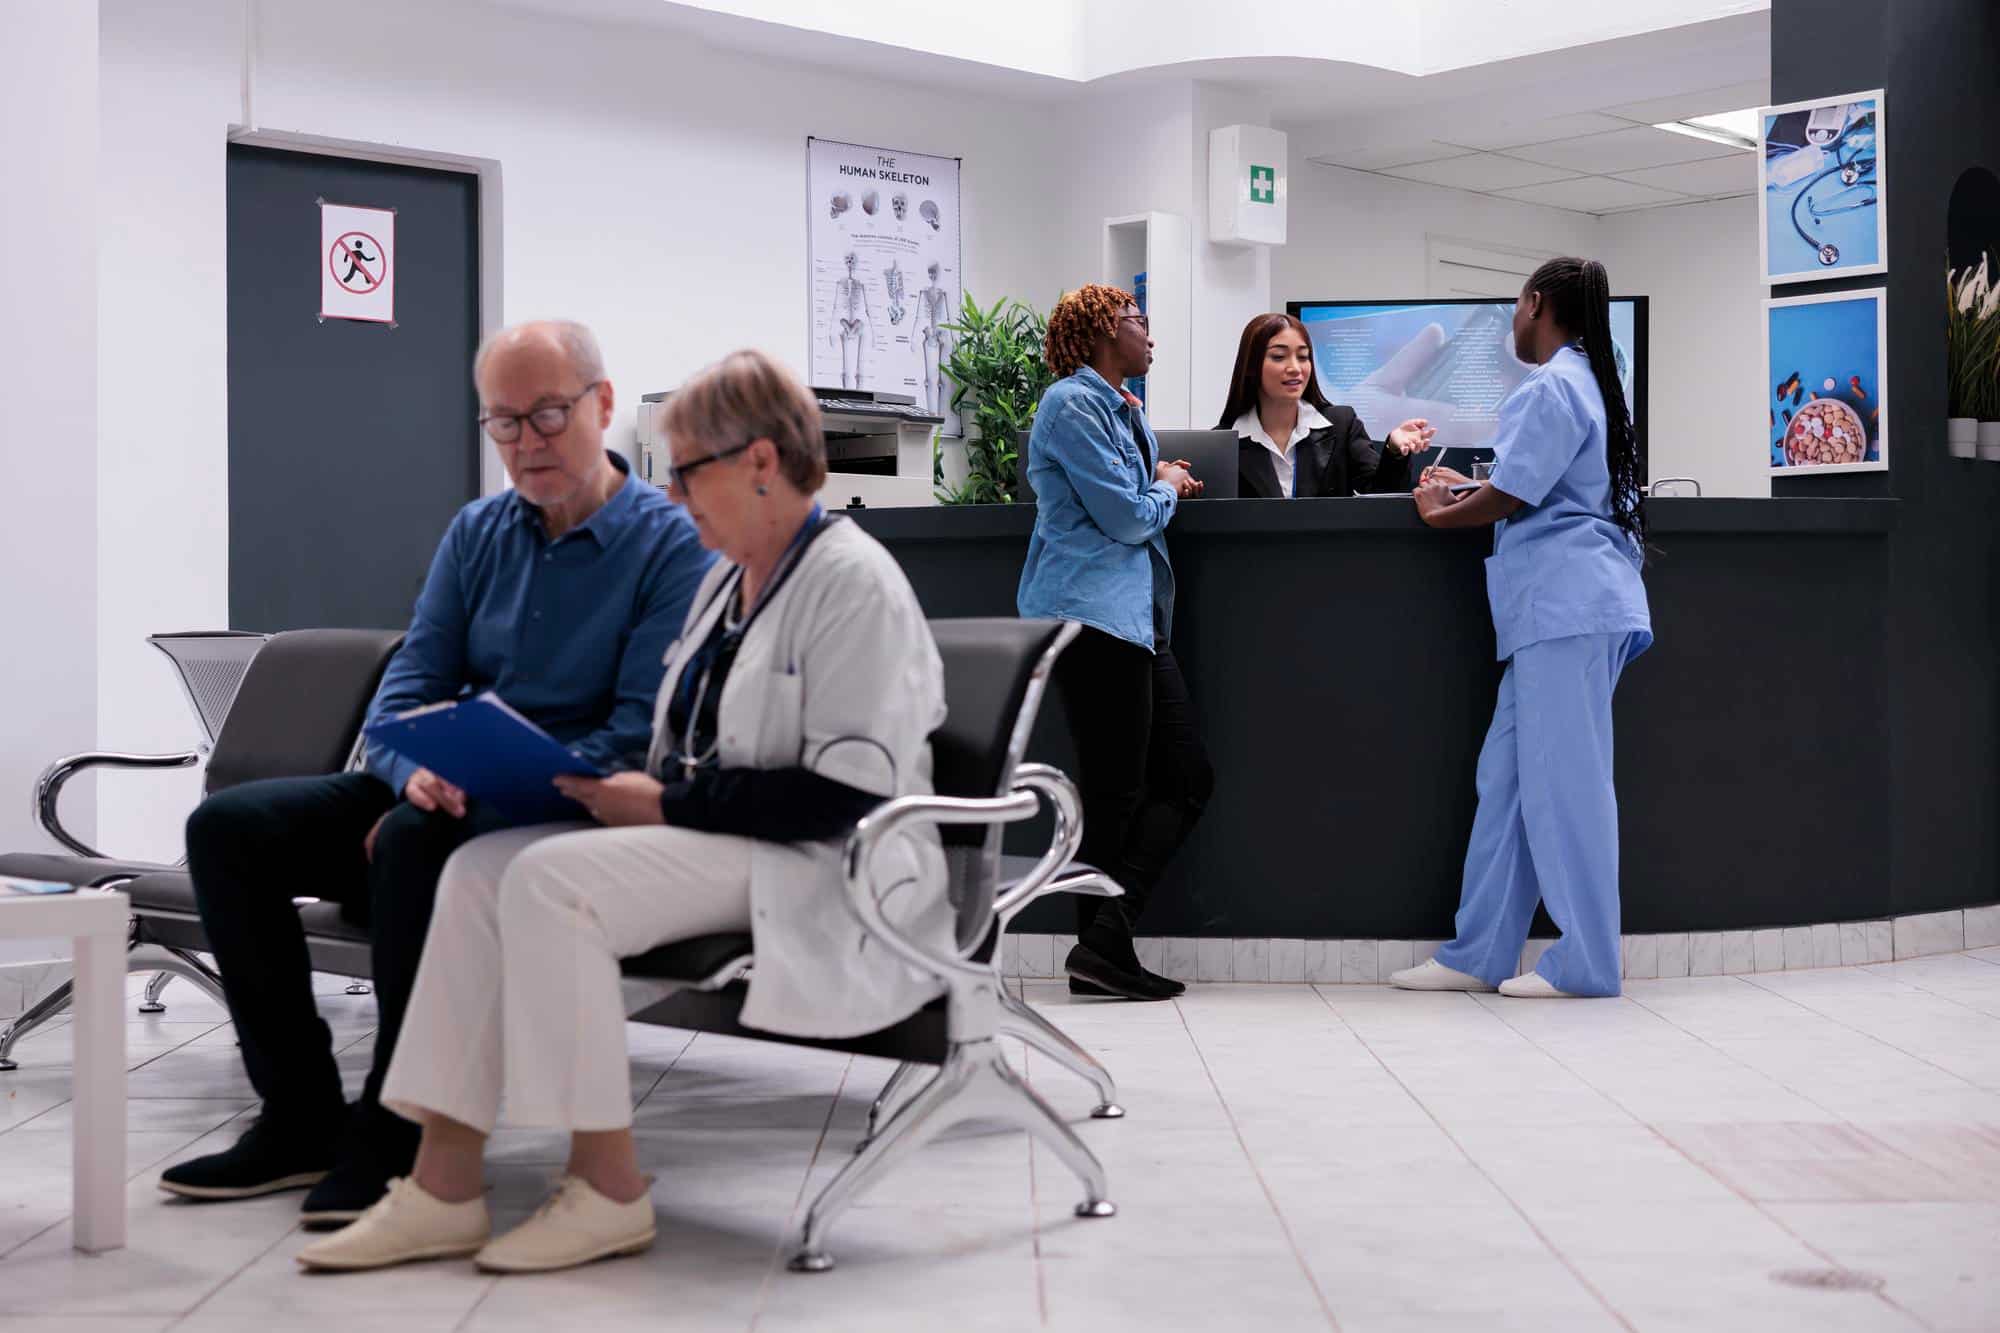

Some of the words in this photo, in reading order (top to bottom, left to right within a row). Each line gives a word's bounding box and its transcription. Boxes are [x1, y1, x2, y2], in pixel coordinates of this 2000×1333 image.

[877, 156, 896, 168] THE
[839, 165, 877, 179] HUMAN
[879, 170, 929, 186] SKELETON
